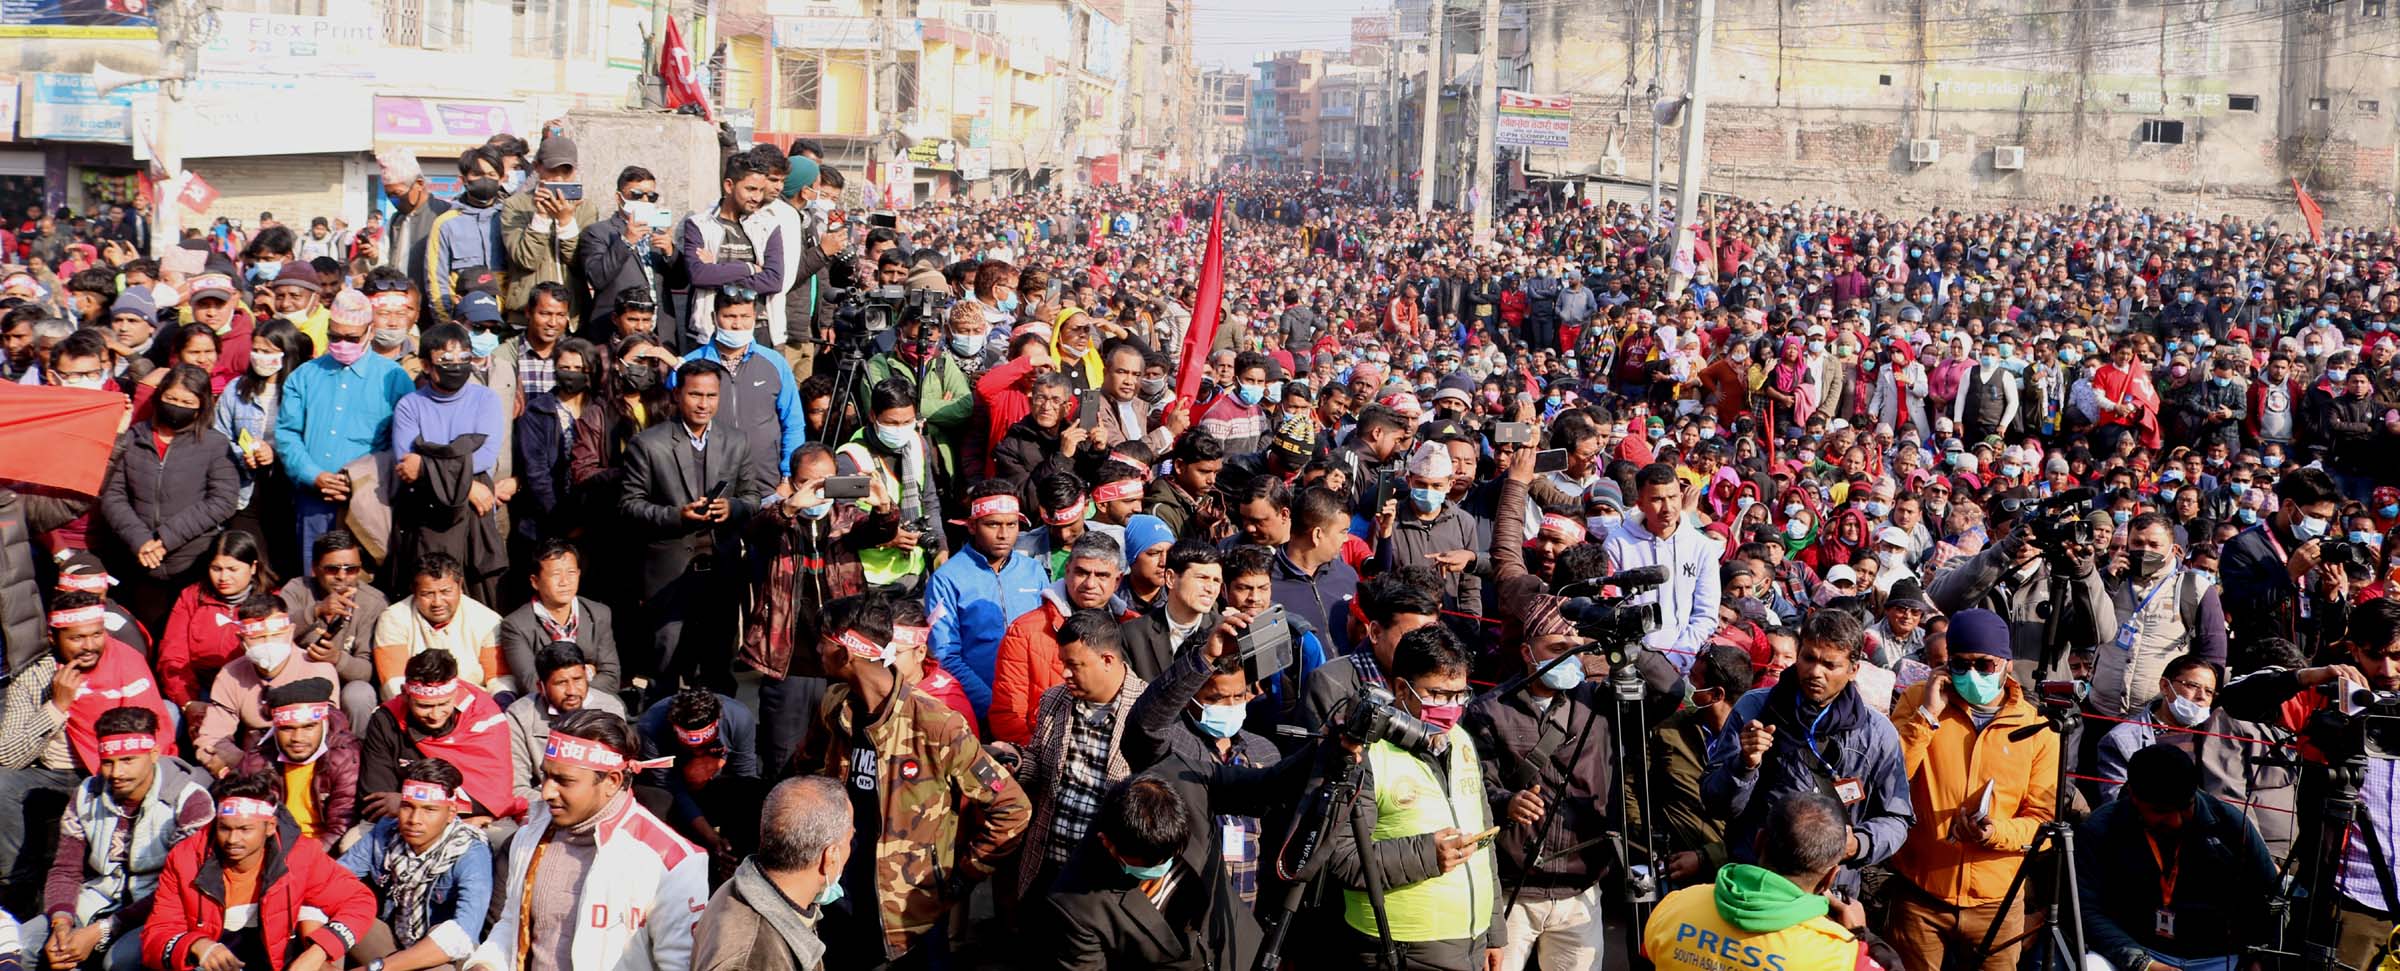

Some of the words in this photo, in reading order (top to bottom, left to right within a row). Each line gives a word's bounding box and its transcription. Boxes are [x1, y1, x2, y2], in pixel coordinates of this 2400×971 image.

[248, 17, 304, 37] Flex
[313, 20, 377, 40] Print
[1520, 133, 1567, 141] COMPUTER
[1673, 947, 1699, 968] SOUTH
[1676, 922, 1787, 971] PRESS
